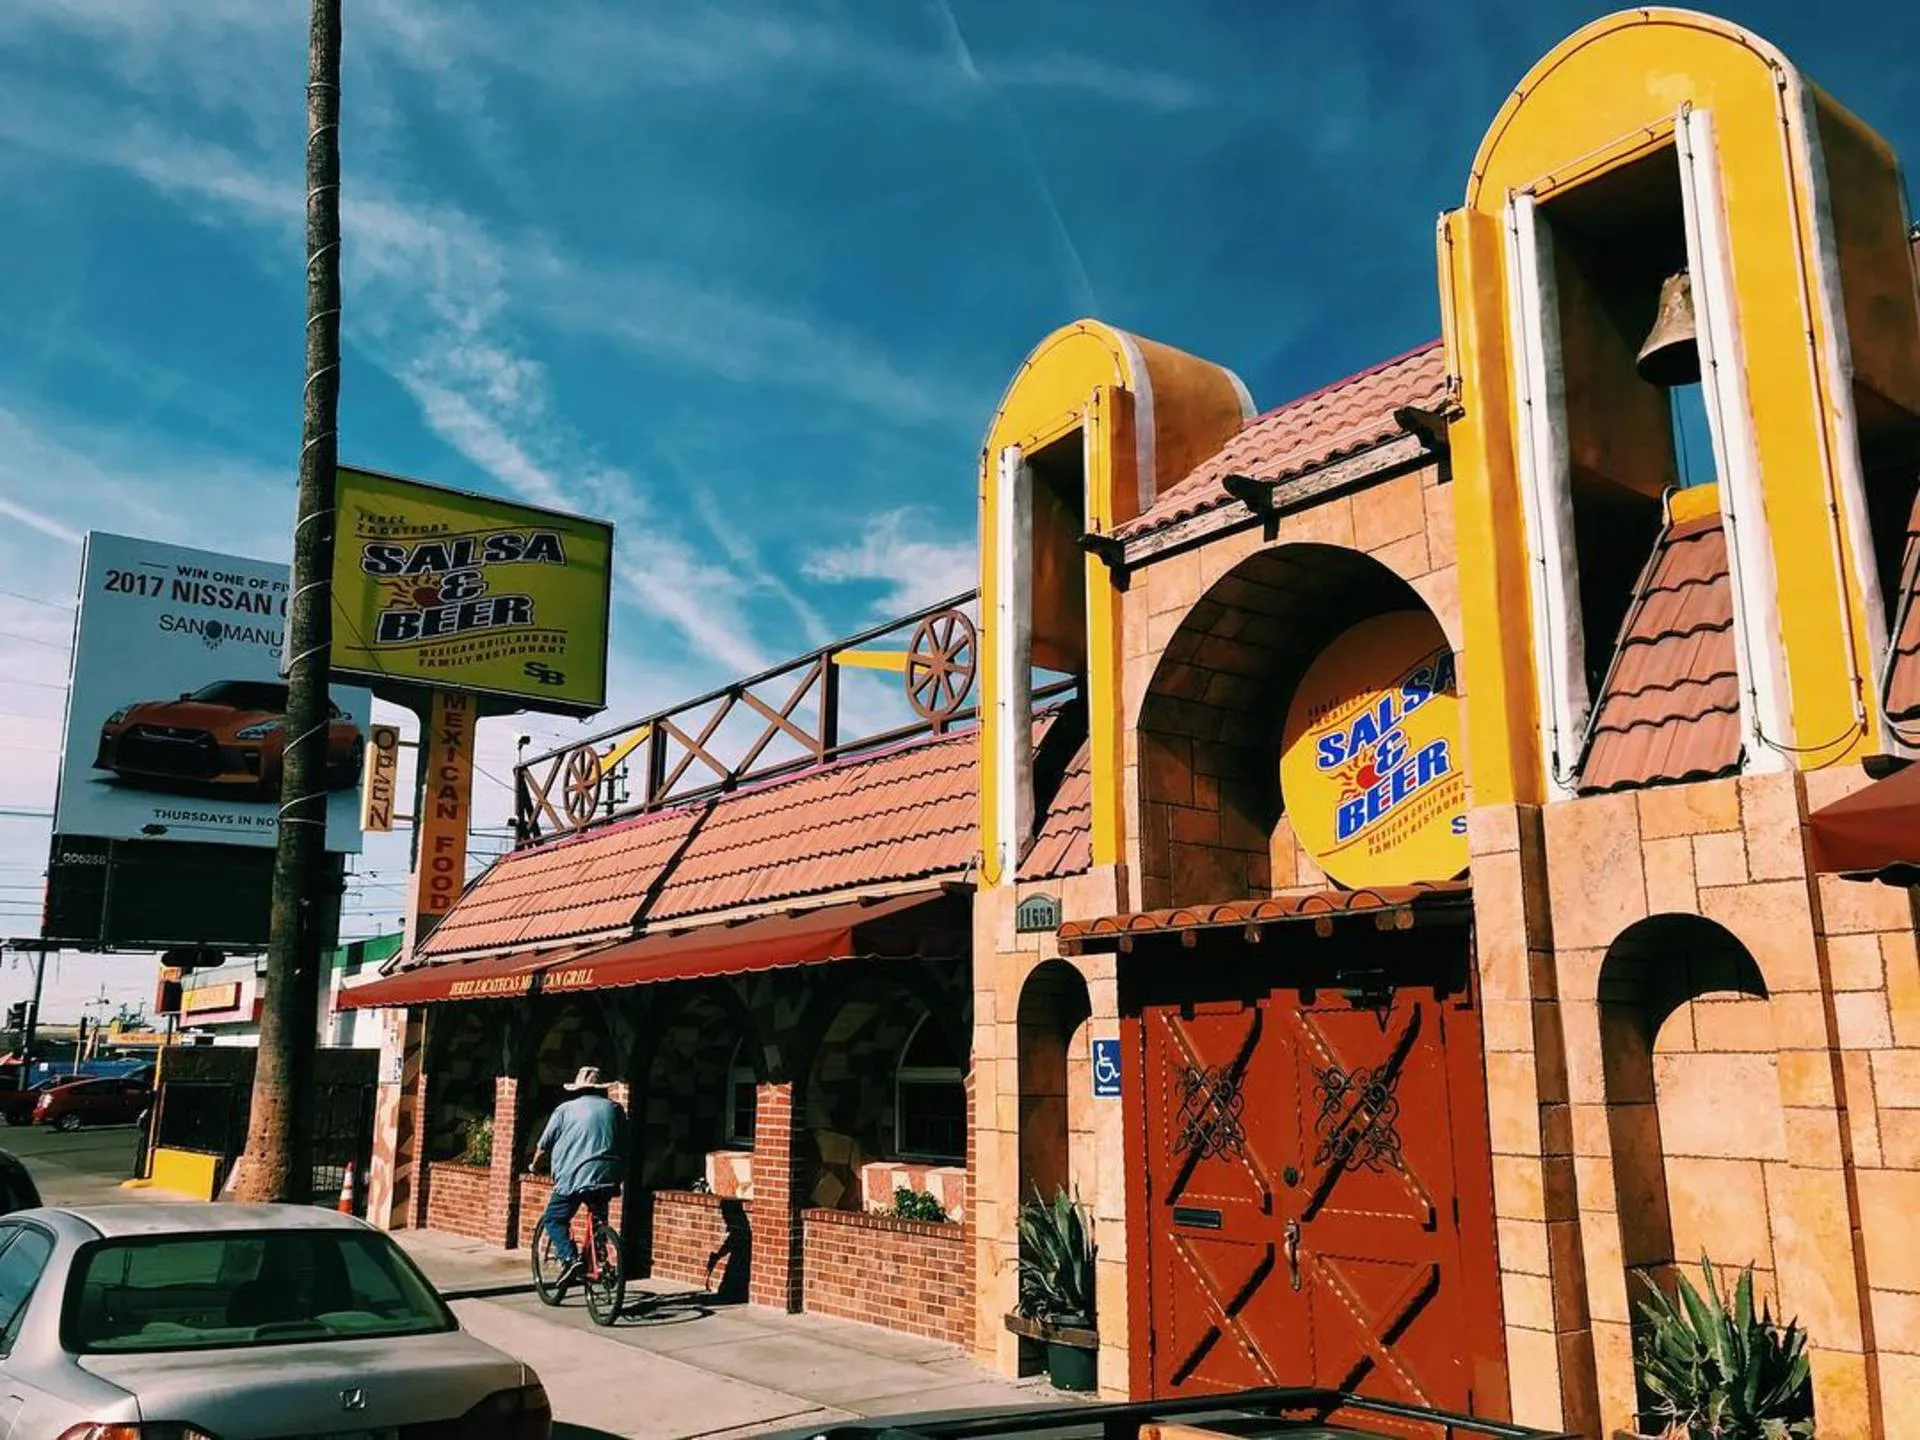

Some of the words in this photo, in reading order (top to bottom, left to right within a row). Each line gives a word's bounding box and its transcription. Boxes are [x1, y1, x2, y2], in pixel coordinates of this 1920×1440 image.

[361, 530, 568, 577] SALSA
[104, 570, 164, 598] 2017
[172, 578, 272, 616] NISSAN
[177, 565, 208, 579] WIN
[213, 571, 245, 586] ONE
[249, 578, 268, 589] OF
[438, 569, 489, 603] &
[159, 613, 204, 635] SAN
[374, 594, 535, 645] BEER
[418, 654, 472, 667] FAMILY
[475, 645, 566, 662] RESTAURANT
[419, 642, 475, 657] MEXICAN
[1316, 651, 1457, 770] SALSA
[437, 692, 467, 821] MEXICAN
[1374, 730, 1409, 776] &
[369, 728, 396, 829] OPEN
[1335, 738, 1452, 844] BEER
[153, 808, 234, 824] THURSDAYS
[238, 815, 251, 825] IN
[429, 836, 454, 910] FOOD
